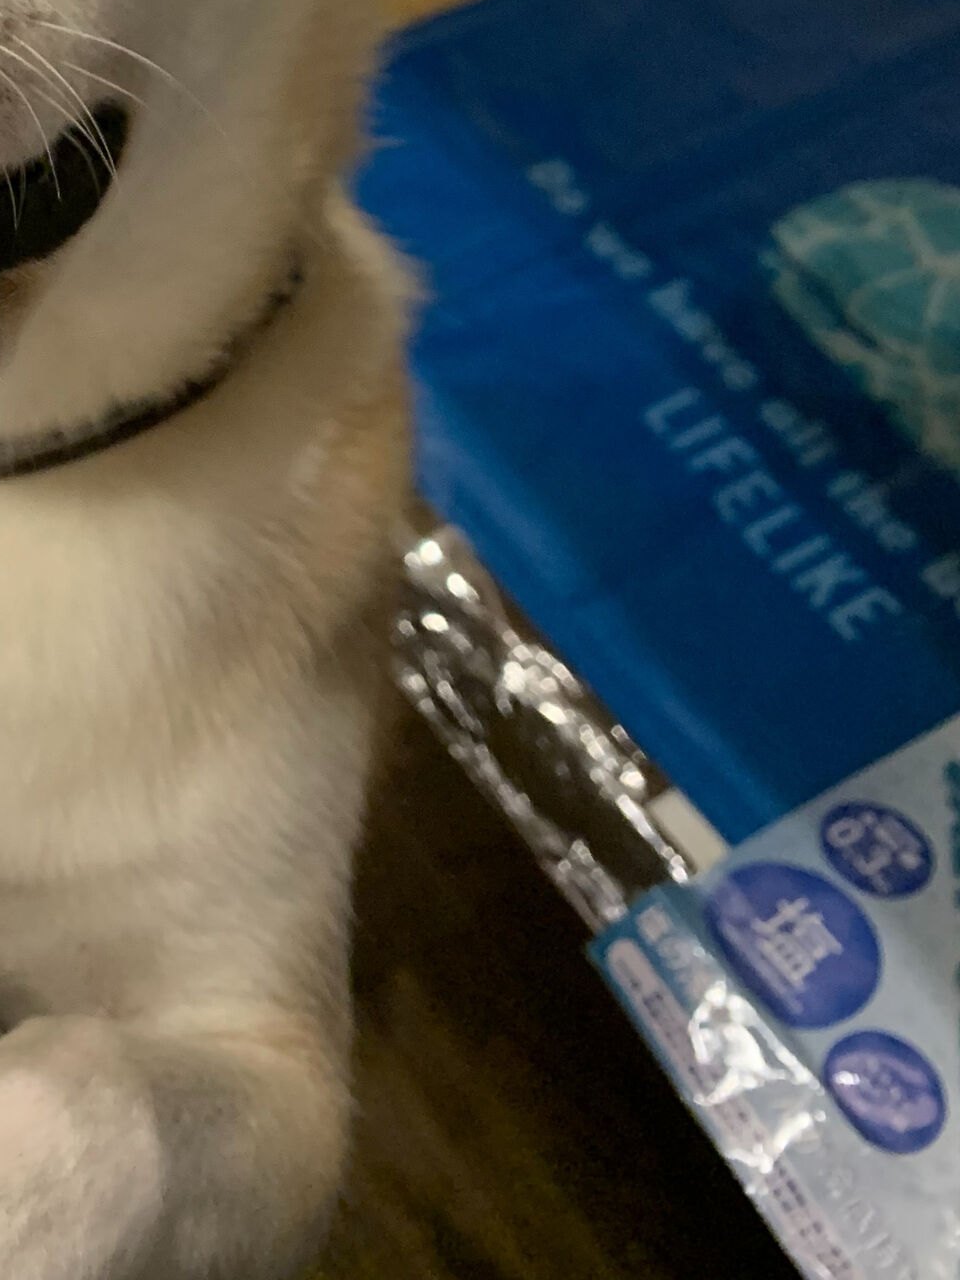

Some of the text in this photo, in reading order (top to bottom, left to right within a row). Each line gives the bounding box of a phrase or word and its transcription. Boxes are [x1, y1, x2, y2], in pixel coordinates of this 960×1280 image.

[644, 387, 902, 640] LIFELIKE
[760, 401, 836, 466] all
[828, 474, 916, 551] the
